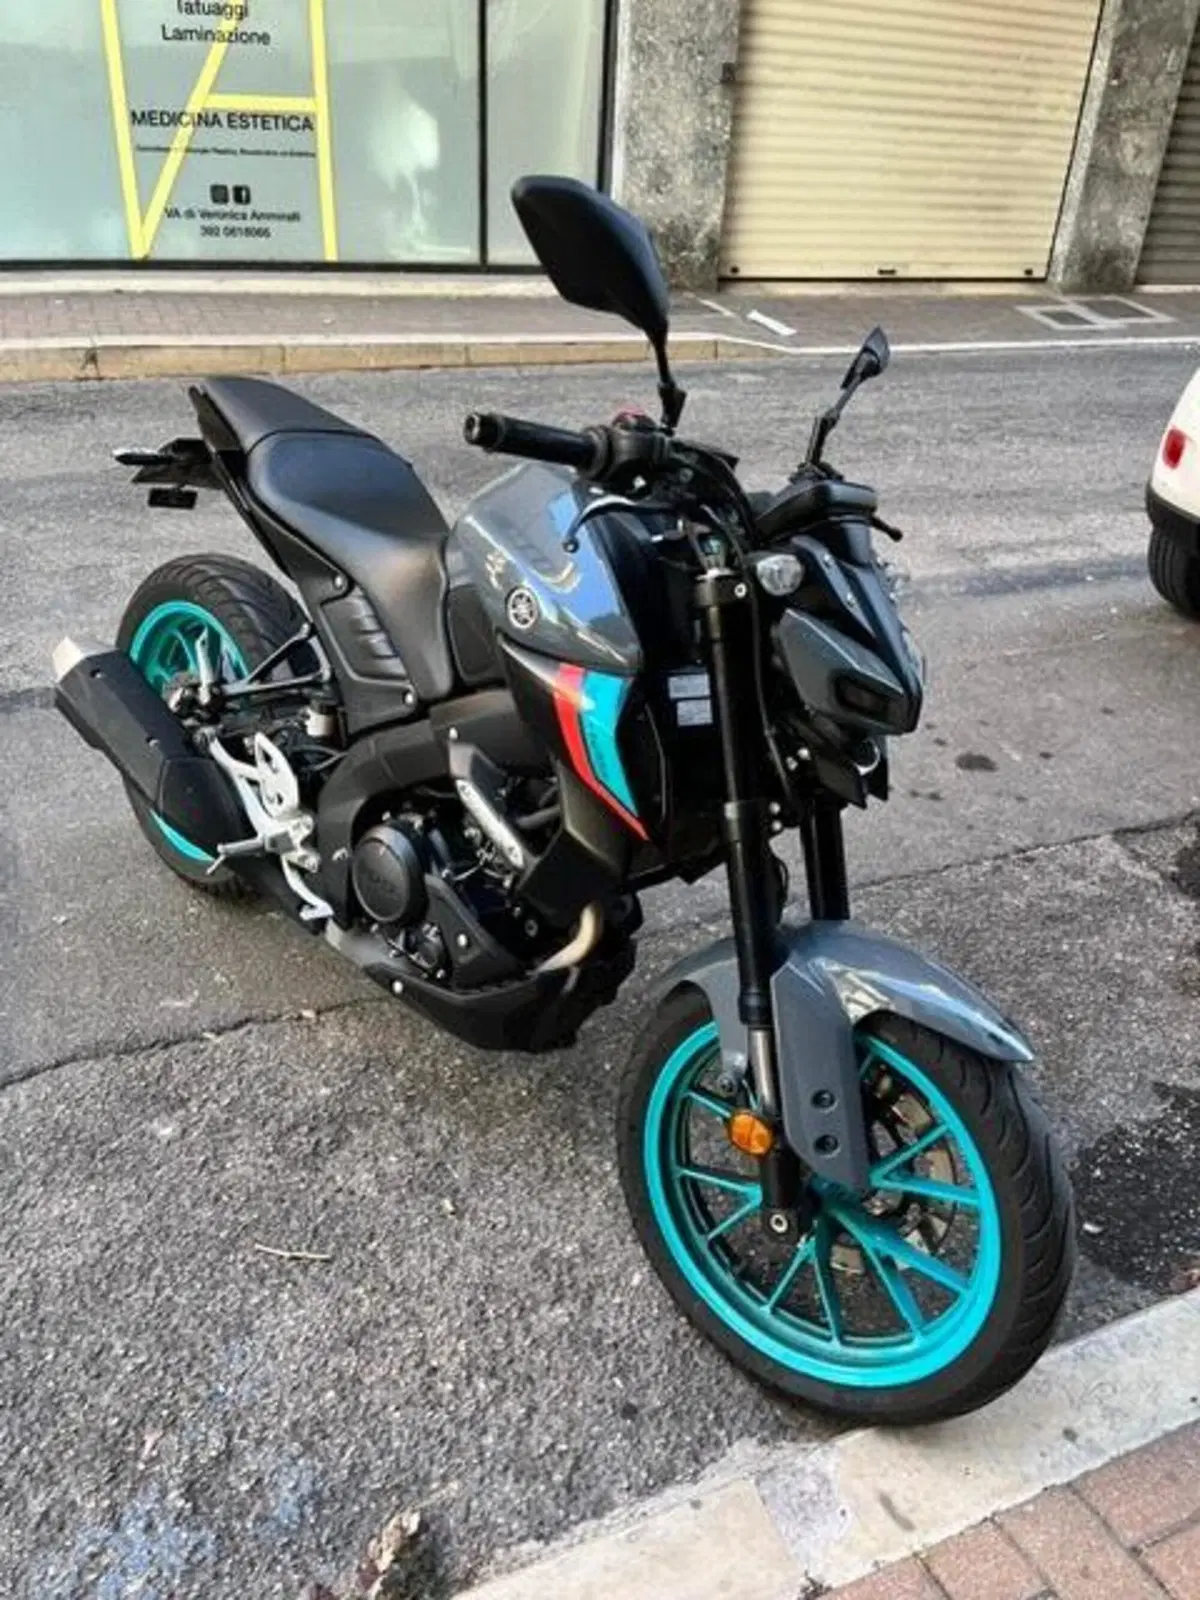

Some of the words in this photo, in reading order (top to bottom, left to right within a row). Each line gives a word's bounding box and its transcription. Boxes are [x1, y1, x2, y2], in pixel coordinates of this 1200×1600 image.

[177, 0, 249, 20] Tatuaggi
[161, 23, 271, 46] Laminazione
[131, 110, 223, 129] MEDICINA
[227, 112, 315, 132] ESTETICA
